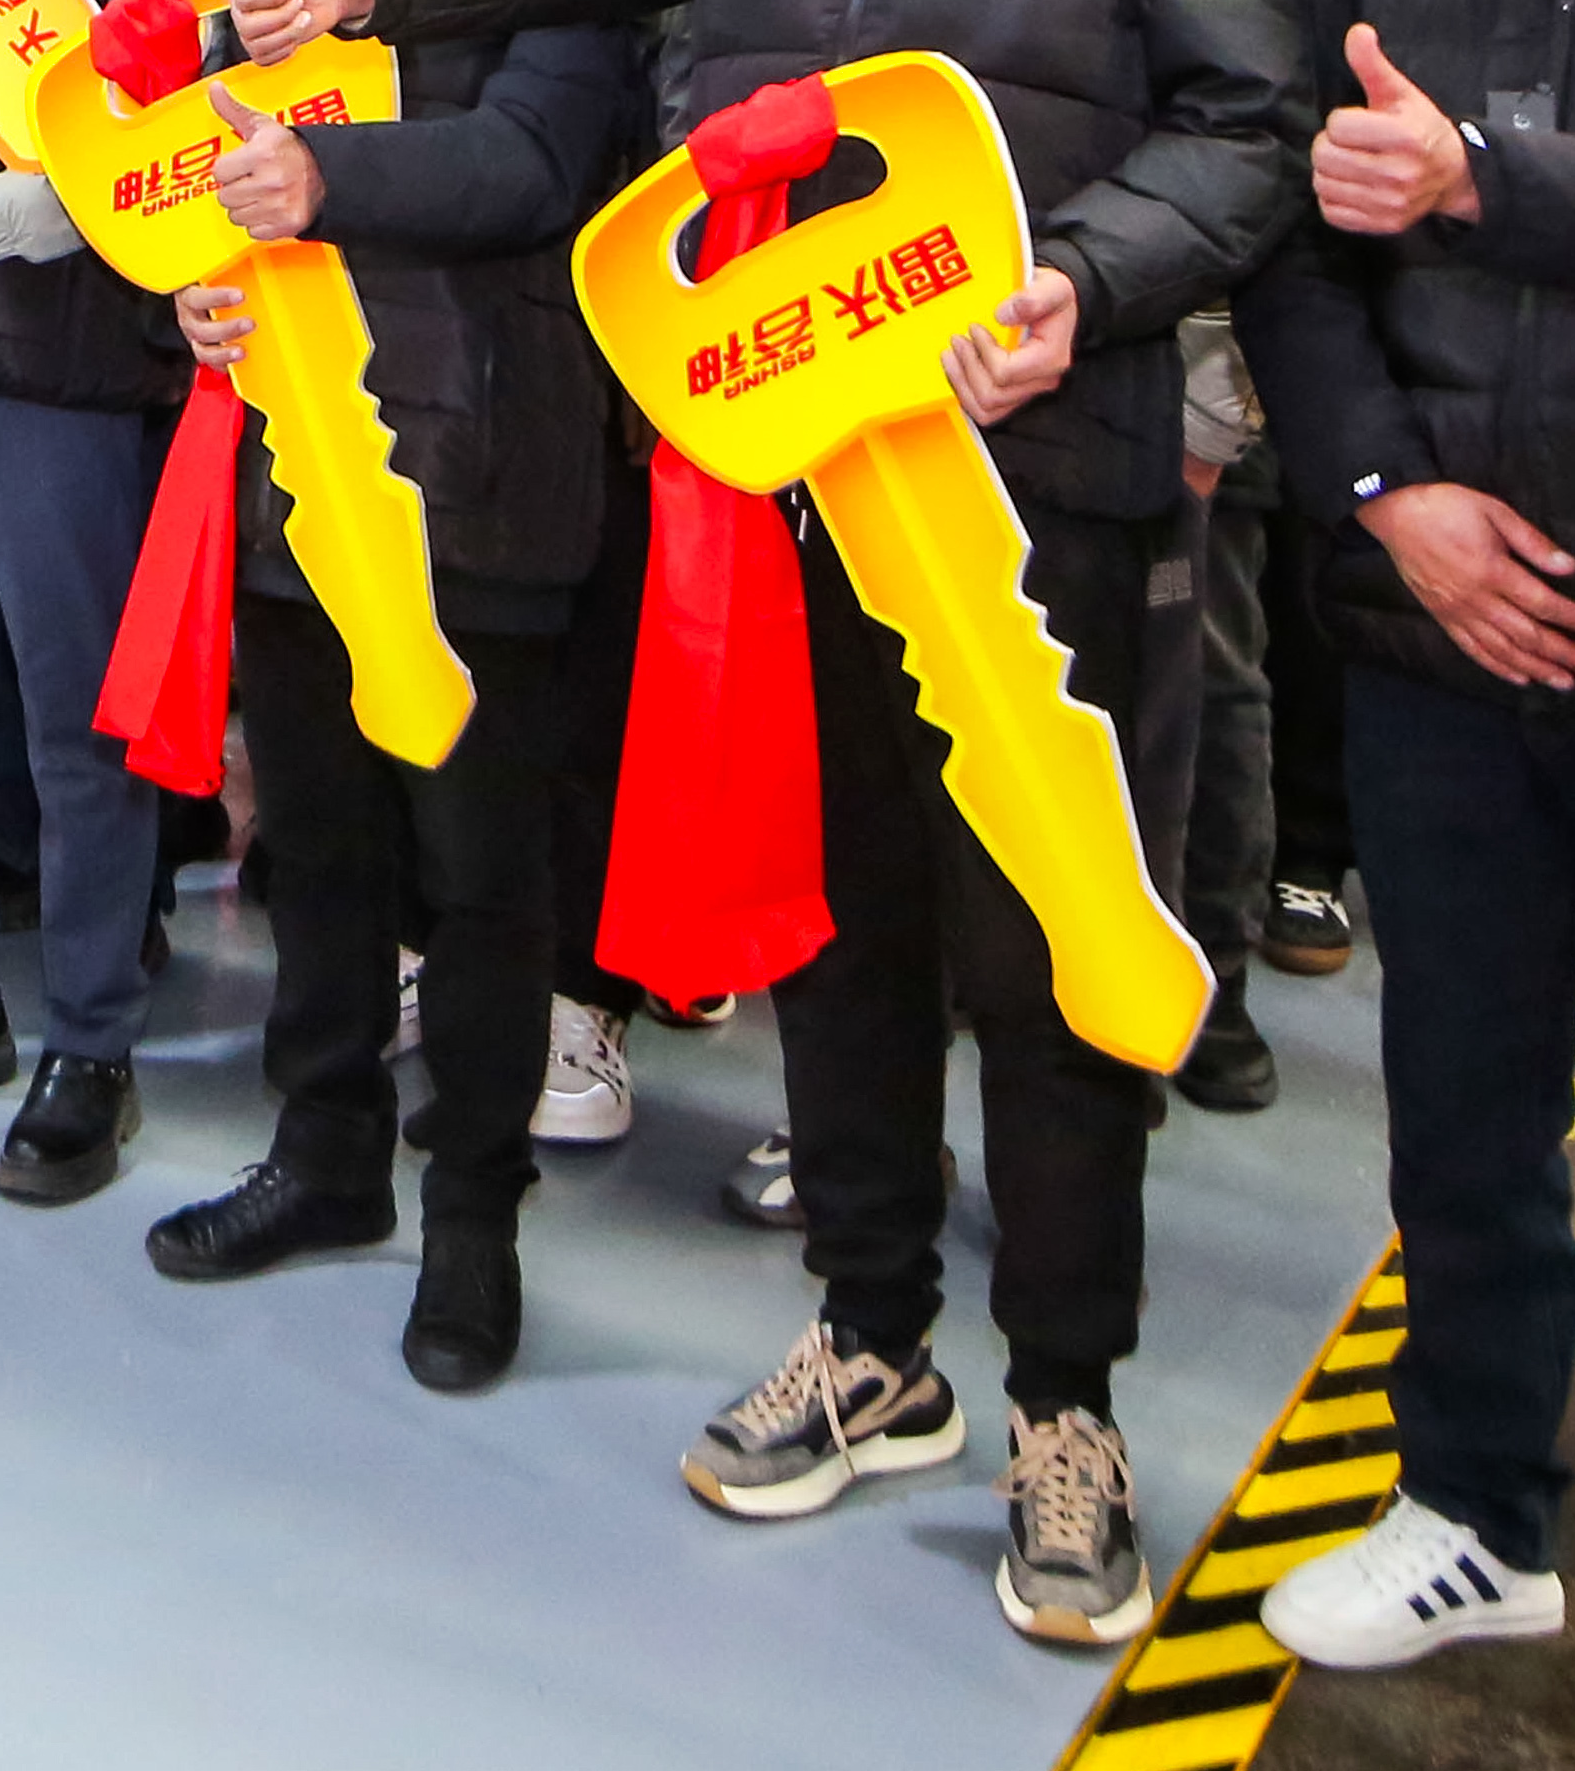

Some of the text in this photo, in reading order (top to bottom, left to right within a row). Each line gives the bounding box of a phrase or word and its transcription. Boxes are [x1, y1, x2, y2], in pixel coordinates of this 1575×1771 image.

[686, 224, 973, 398] 雷沃谷神
[723, 343, 817, 400] ASHNA
